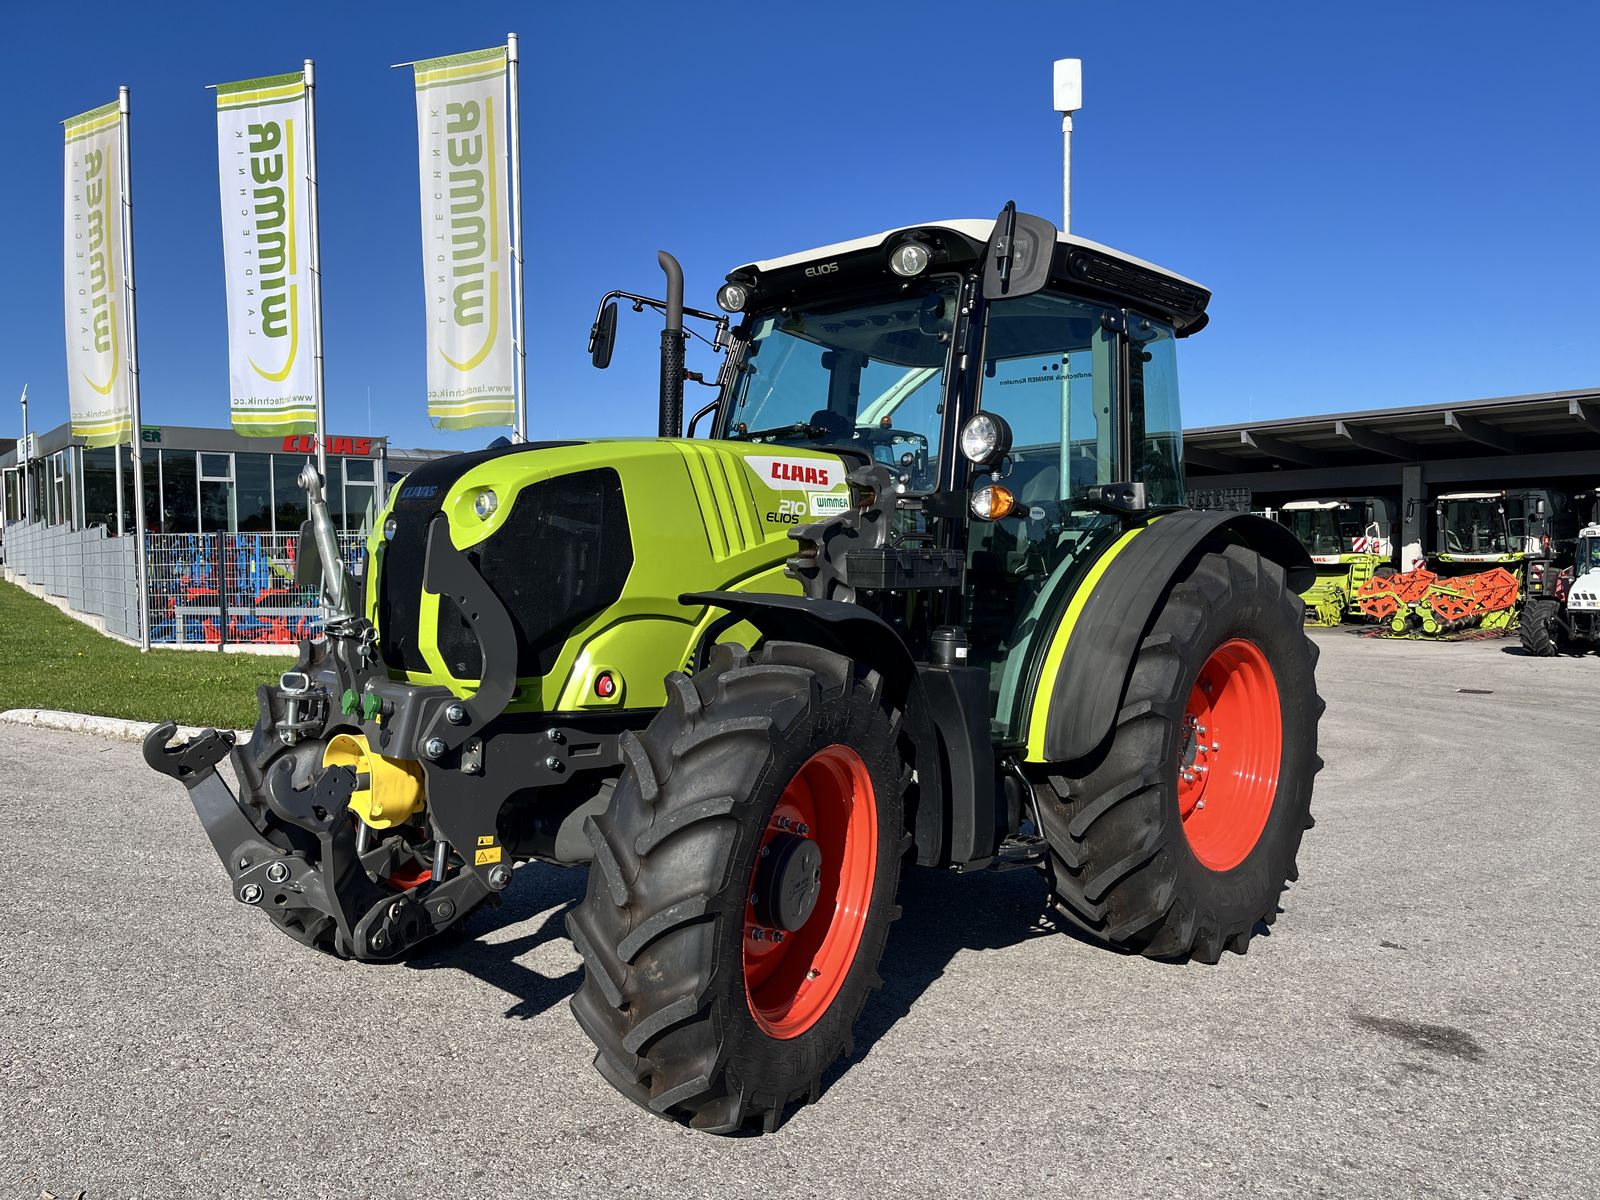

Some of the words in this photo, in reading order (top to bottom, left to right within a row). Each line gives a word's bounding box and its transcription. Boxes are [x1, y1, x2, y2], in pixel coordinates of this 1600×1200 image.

[805, 262, 839, 277] ELIOS
[771, 462, 829, 486] CLAAS
[401, 486, 437, 498] CLAAS
[779, 500, 807, 516] 210
[816, 498, 849, 508] WIMMER
[766, 512, 800, 525] ELIOS
